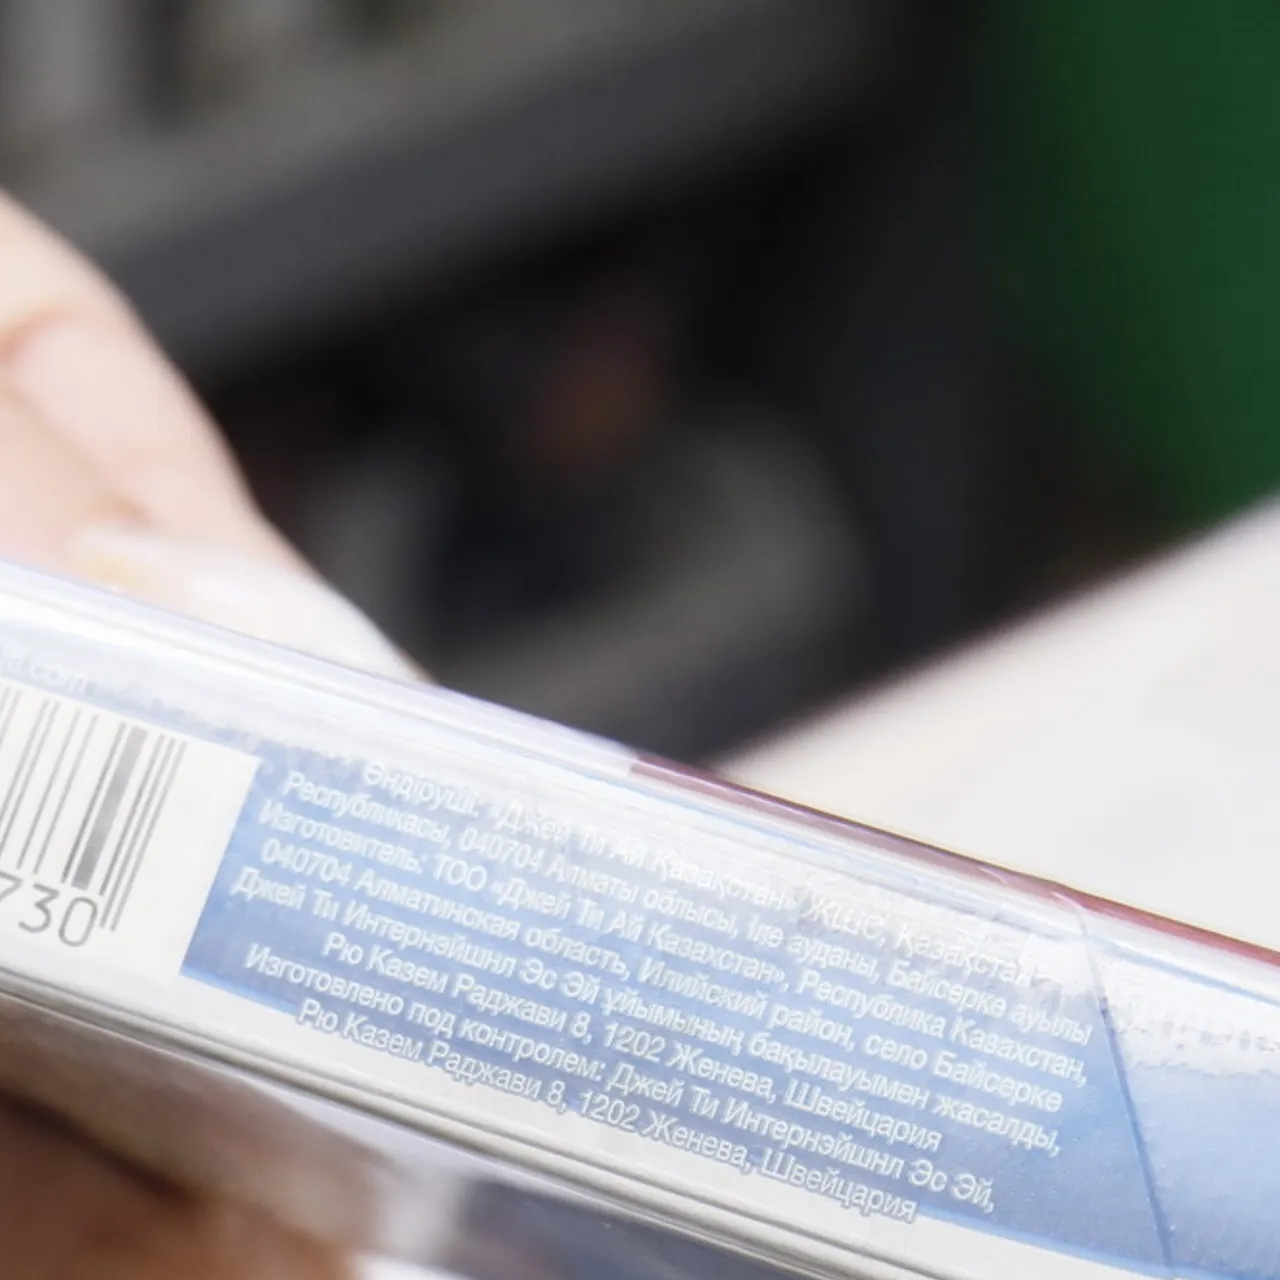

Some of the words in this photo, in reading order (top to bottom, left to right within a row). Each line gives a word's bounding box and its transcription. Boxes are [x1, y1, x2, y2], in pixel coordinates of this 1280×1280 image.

[284, 771, 449, 847] Республикасы,
[460, 826, 543, 871] 040704
[263, 838, 352, 885] 040704
[356, 868, 520, 939] Алматинская
[527, 927, 629, 979] область,
[770, 1006, 853, 1051] район,
[865, 1035, 928, 1069] село
[323, 933, 363, 964] Рю
[367, 947, 447, 992] Казем
[453, 975, 567, 1030] Раджави
[573, 1013, 591, 1043] 8,
[602, 1023, 665, 1062] 1202
[666, 1044, 775, 1103] Женева,
[784, 1081, 942, 1151] Швейцария
[435, 855, 488, 890] ТОО
[798, 970, 946, 1036] Республика
[951, 1019, 1086, 1086] Казахстан,
[524, 959, 557, 988] Эс
[245, 945, 404, 1016] Изготовлено
[408, 1003, 455, 1037] под
[461, 1021, 605, 1081] контролем:
[606, 1063, 684, 1106] Джей
[691, 1089, 719, 1117] Ти
[722, 1100, 904, 1178] Интернэйшнл
[912, 1161, 947, 1191] Эс
[955, 1175, 994, 1212] Эй,
[298, 999, 338, 1030] Рю
[343, 1014, 423, 1059] Казем
[428, 1042, 542, 1098] Раджави
[548, 1081, 566, 1111] 8,
[578, 1091, 641, 1130] 1202
[642, 1112, 752, 1172] Женева,
[760, 1150, 918, 1221] Швейцария
